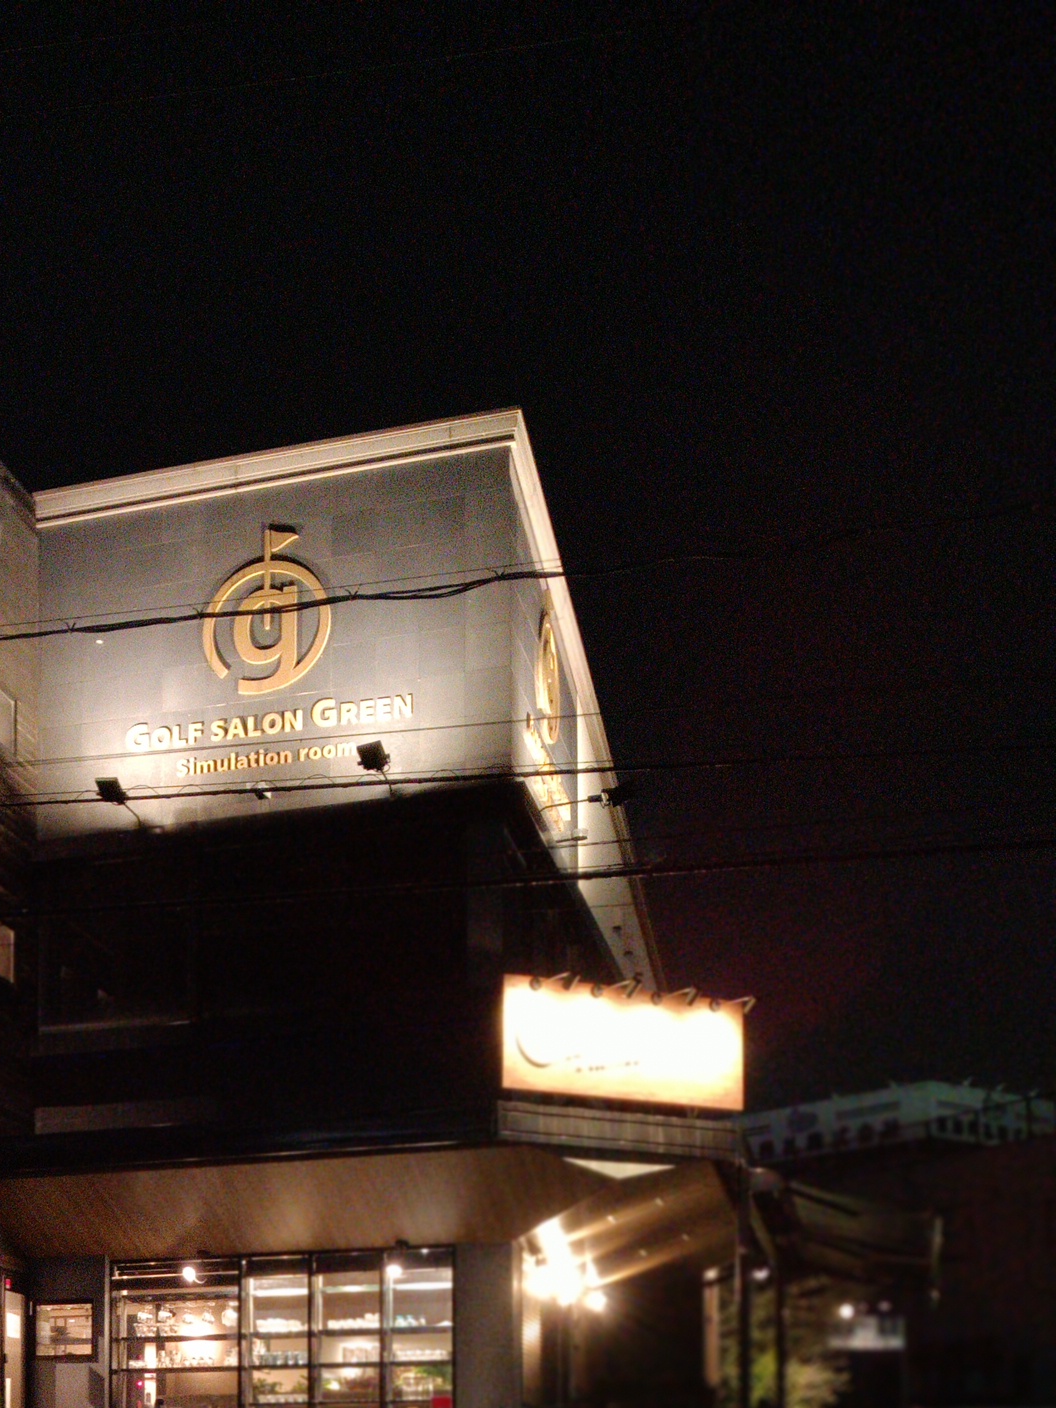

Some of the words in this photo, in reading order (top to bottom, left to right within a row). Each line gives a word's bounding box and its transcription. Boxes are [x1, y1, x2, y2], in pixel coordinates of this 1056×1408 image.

[125, 723, 204, 752] GOLF
[210, 709, 303, 742] SALON
[311, 694, 414, 728] GREEN
[176, 748, 293, 778] Simulation
[300, 740, 358, 763] room
